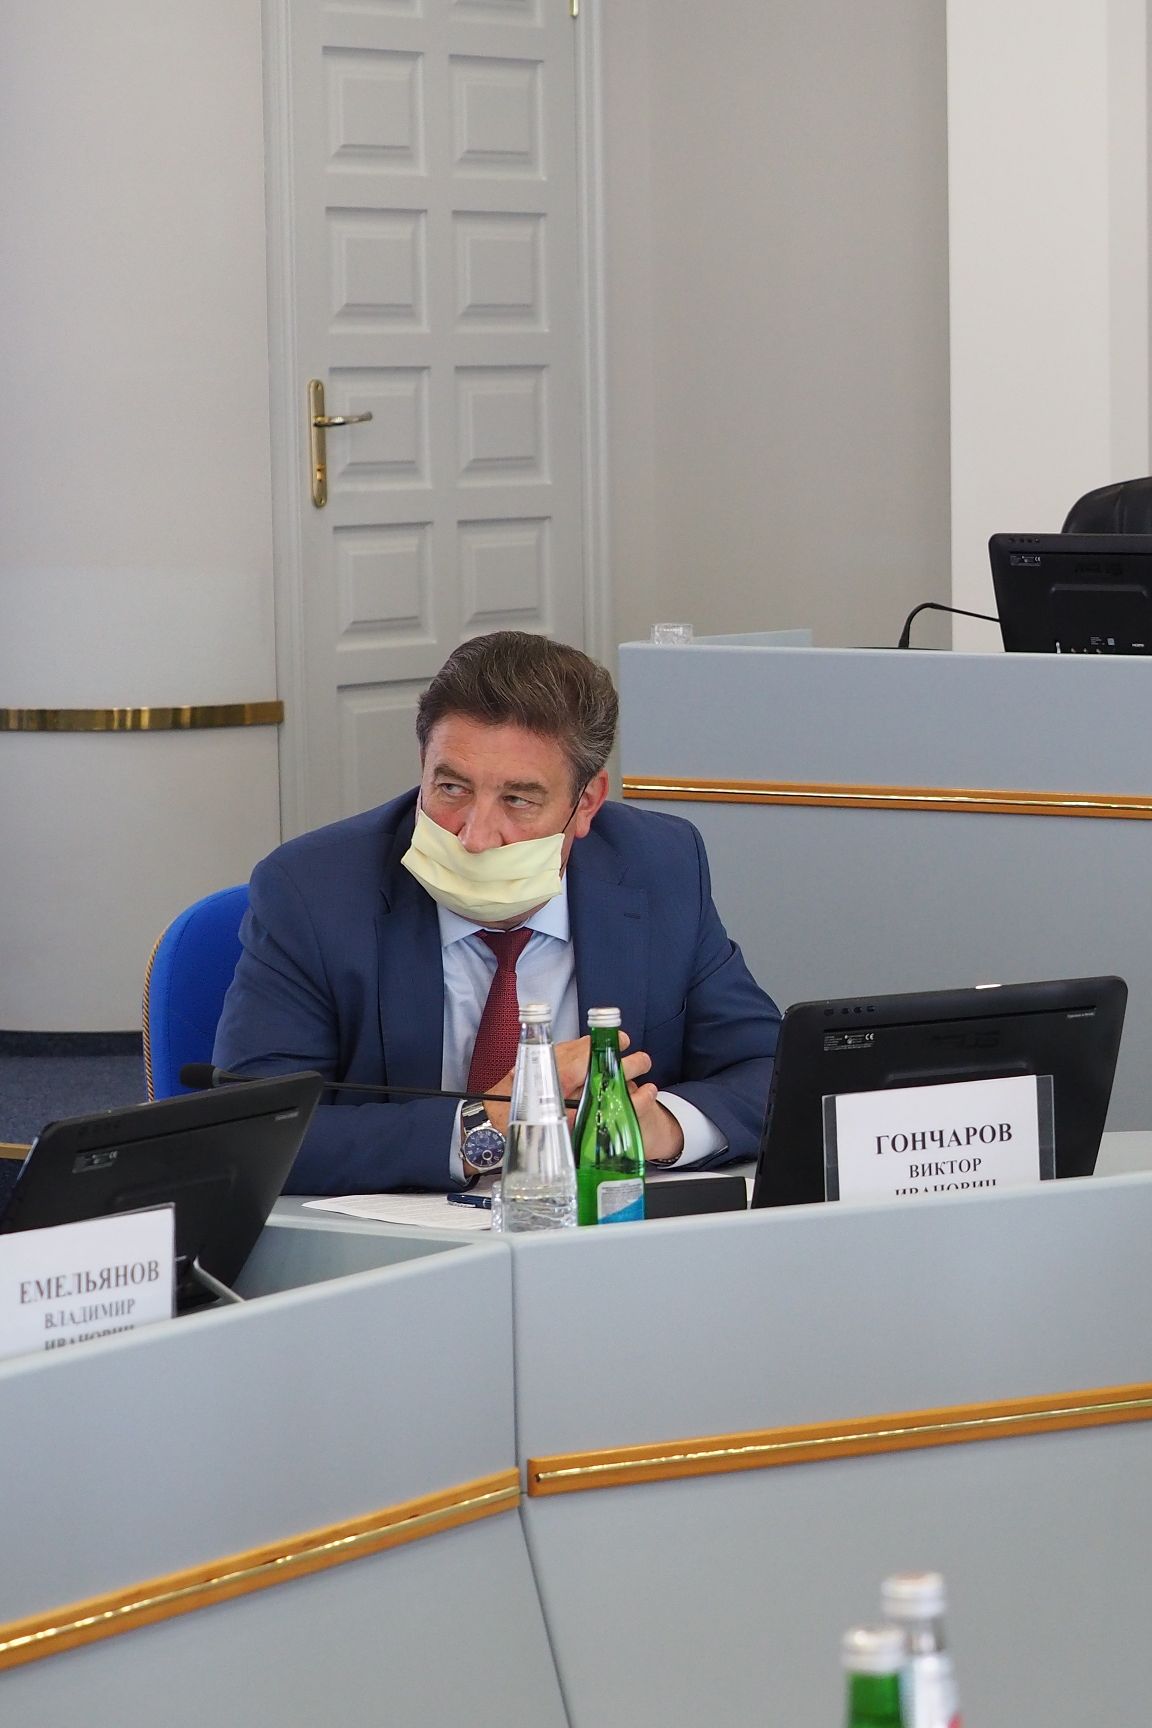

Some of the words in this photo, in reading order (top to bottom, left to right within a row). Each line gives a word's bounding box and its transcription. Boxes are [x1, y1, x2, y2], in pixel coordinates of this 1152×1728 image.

[876, 1123, 1012, 1154] ГОНЧАРОВ
[909, 1158, 981, 1178] ВИКТОР
[20, 1260, 159, 1304] ЕМЕЛЬЯНОВ
[44, 1299, 135, 1329] ВЛАДИМИР
